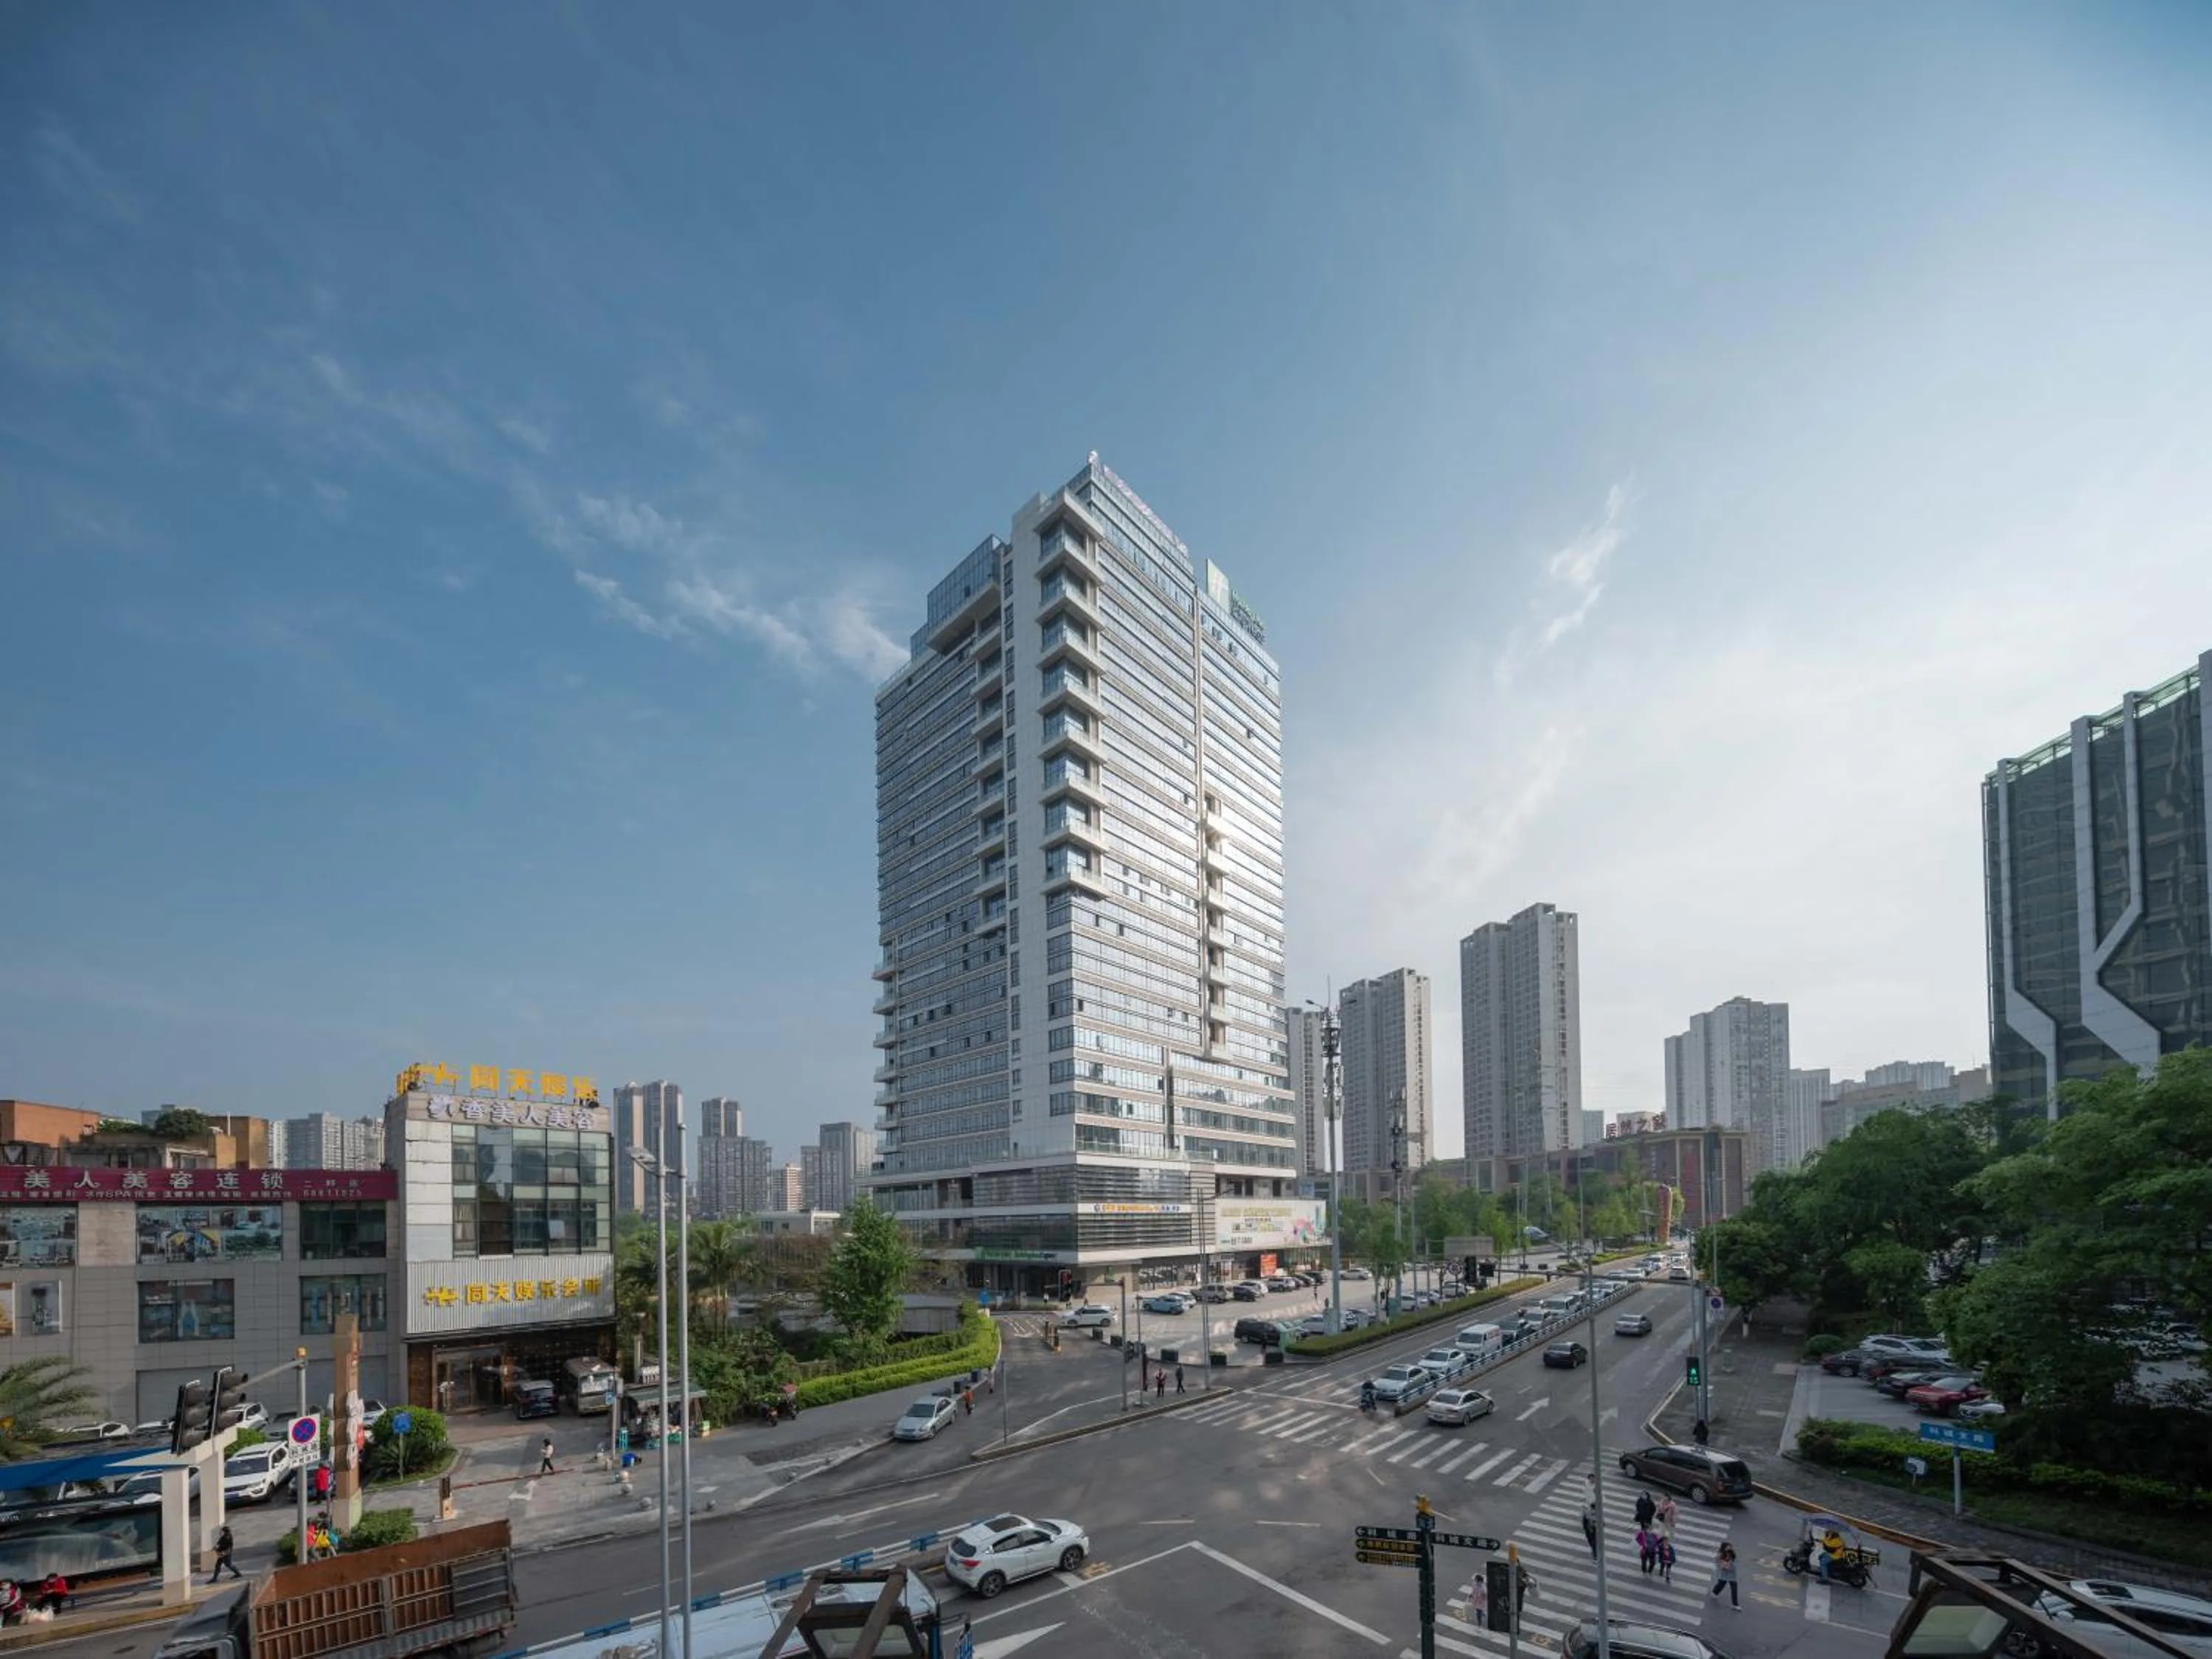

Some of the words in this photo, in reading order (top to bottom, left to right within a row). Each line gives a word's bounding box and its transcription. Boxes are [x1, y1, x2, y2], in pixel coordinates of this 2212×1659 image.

[24, 1170, 285, 1189] 美人美容连锁
[465, 1277, 601, 1305] 同天娱乐会所
